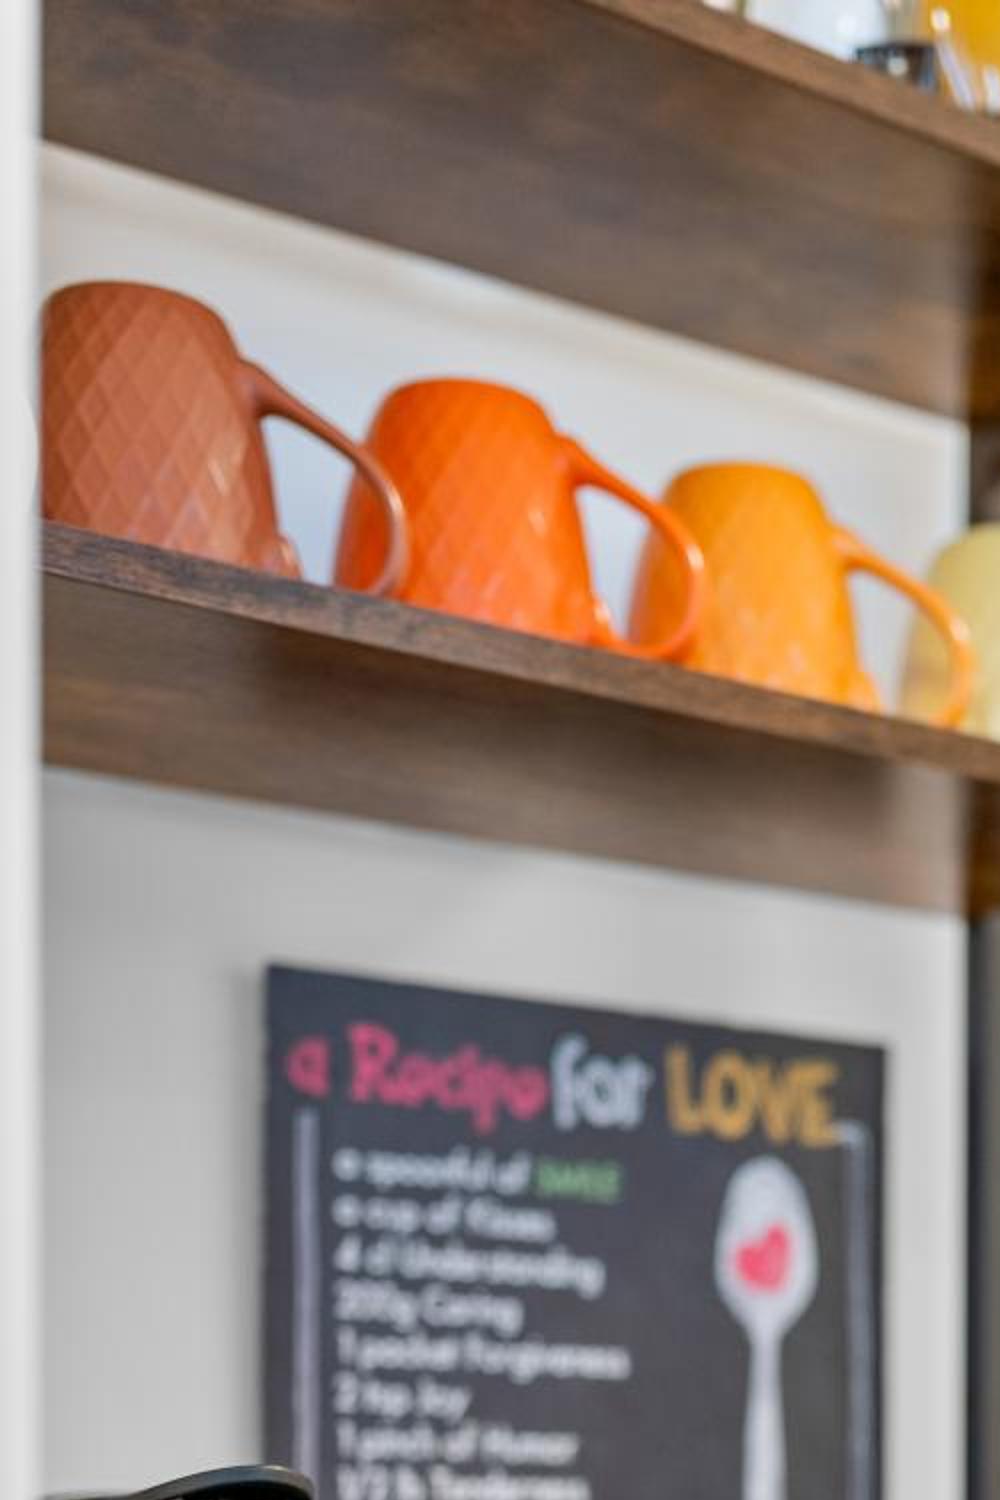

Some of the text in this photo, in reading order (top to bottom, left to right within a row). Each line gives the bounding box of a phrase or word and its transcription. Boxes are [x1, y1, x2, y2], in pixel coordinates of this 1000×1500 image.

[348, 1021, 550, 1138] Recipe
[552, 1033, 655, 1132] for
[664, 1044, 840, 1149] LOVE
